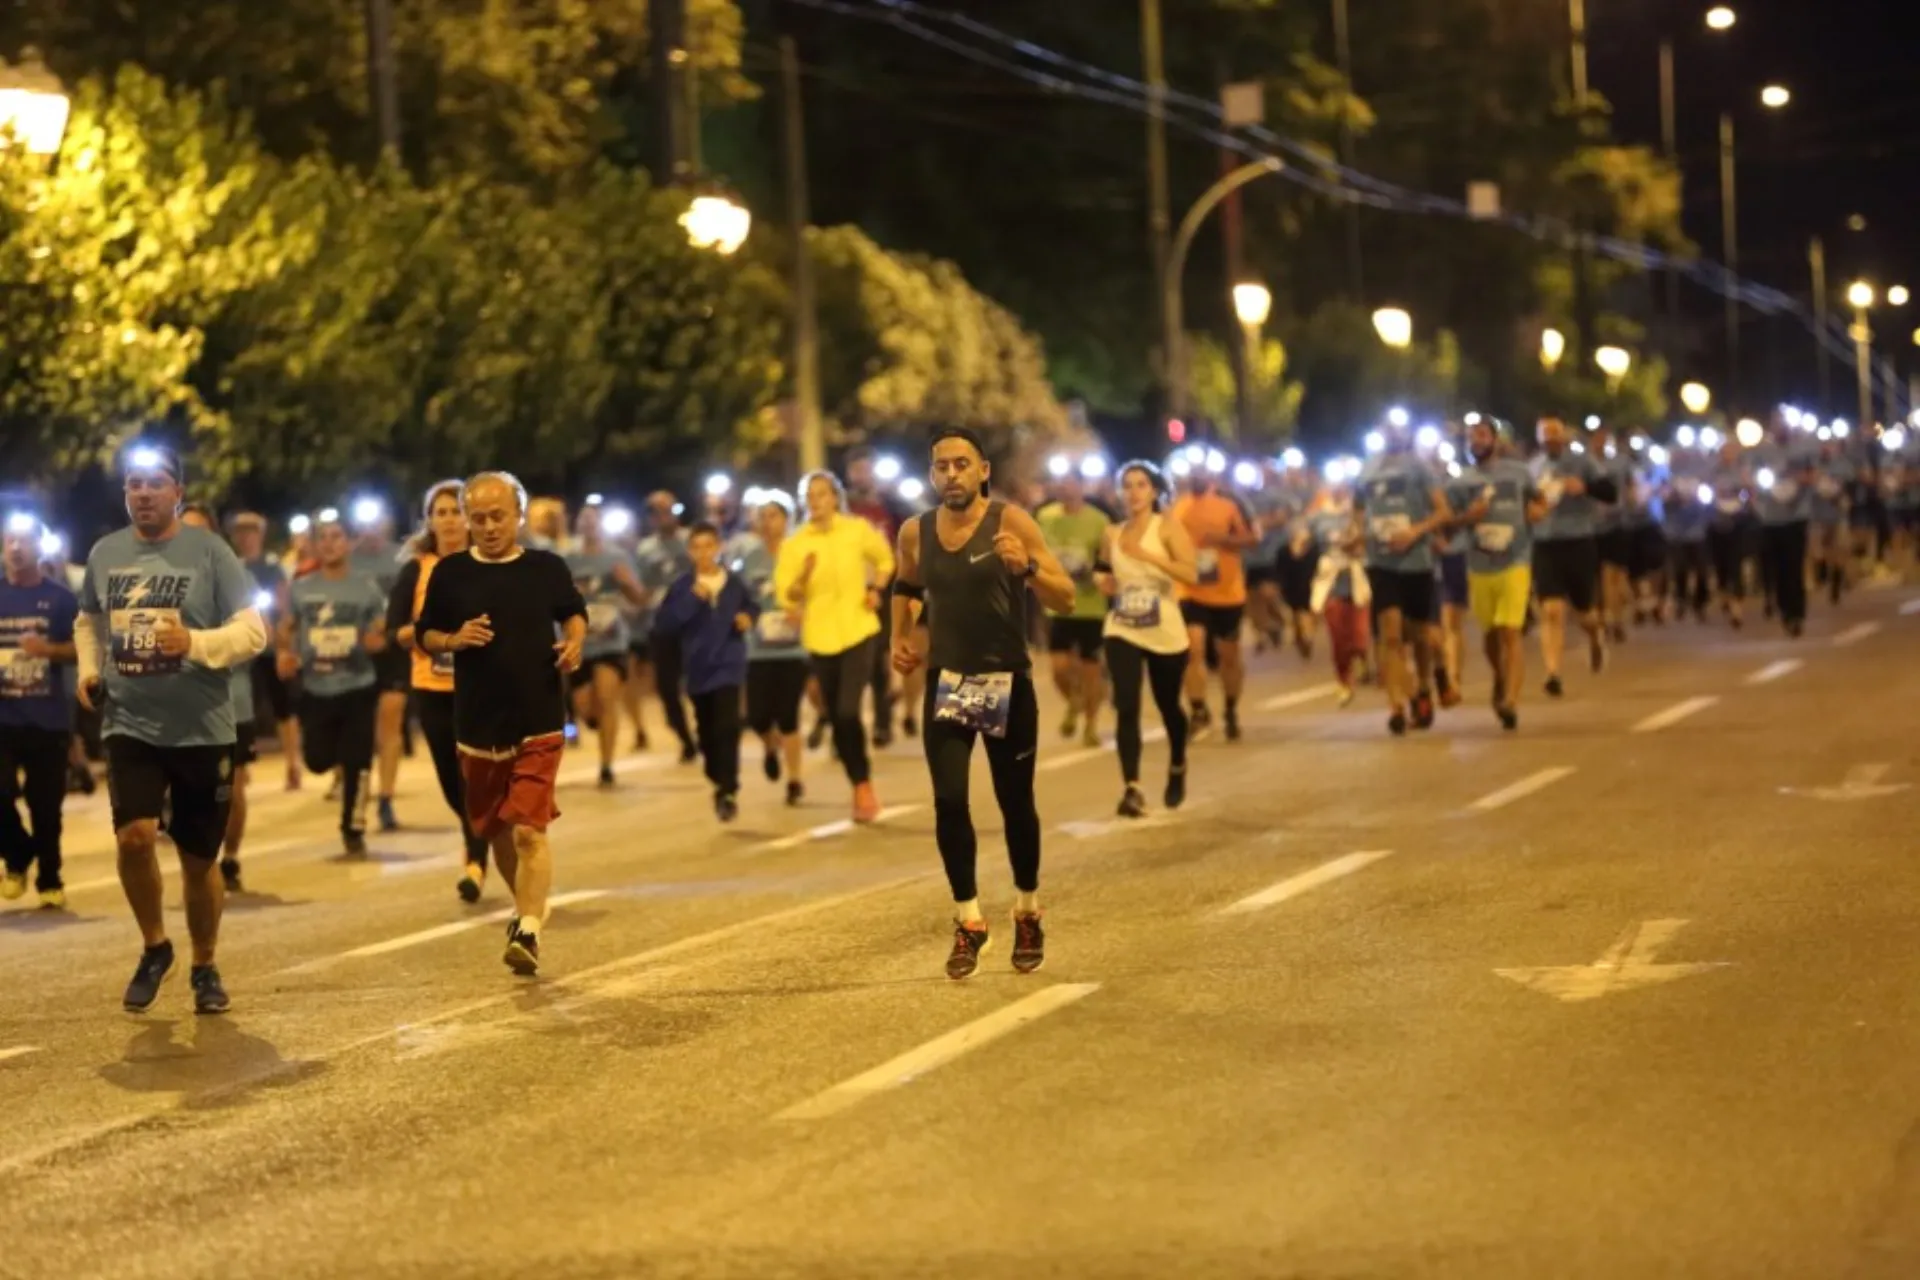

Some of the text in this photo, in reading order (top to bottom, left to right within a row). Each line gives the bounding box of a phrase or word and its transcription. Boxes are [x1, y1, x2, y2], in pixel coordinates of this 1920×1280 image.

[107, 575, 191, 598] WE ARE
[122, 631, 162, 651] 158
